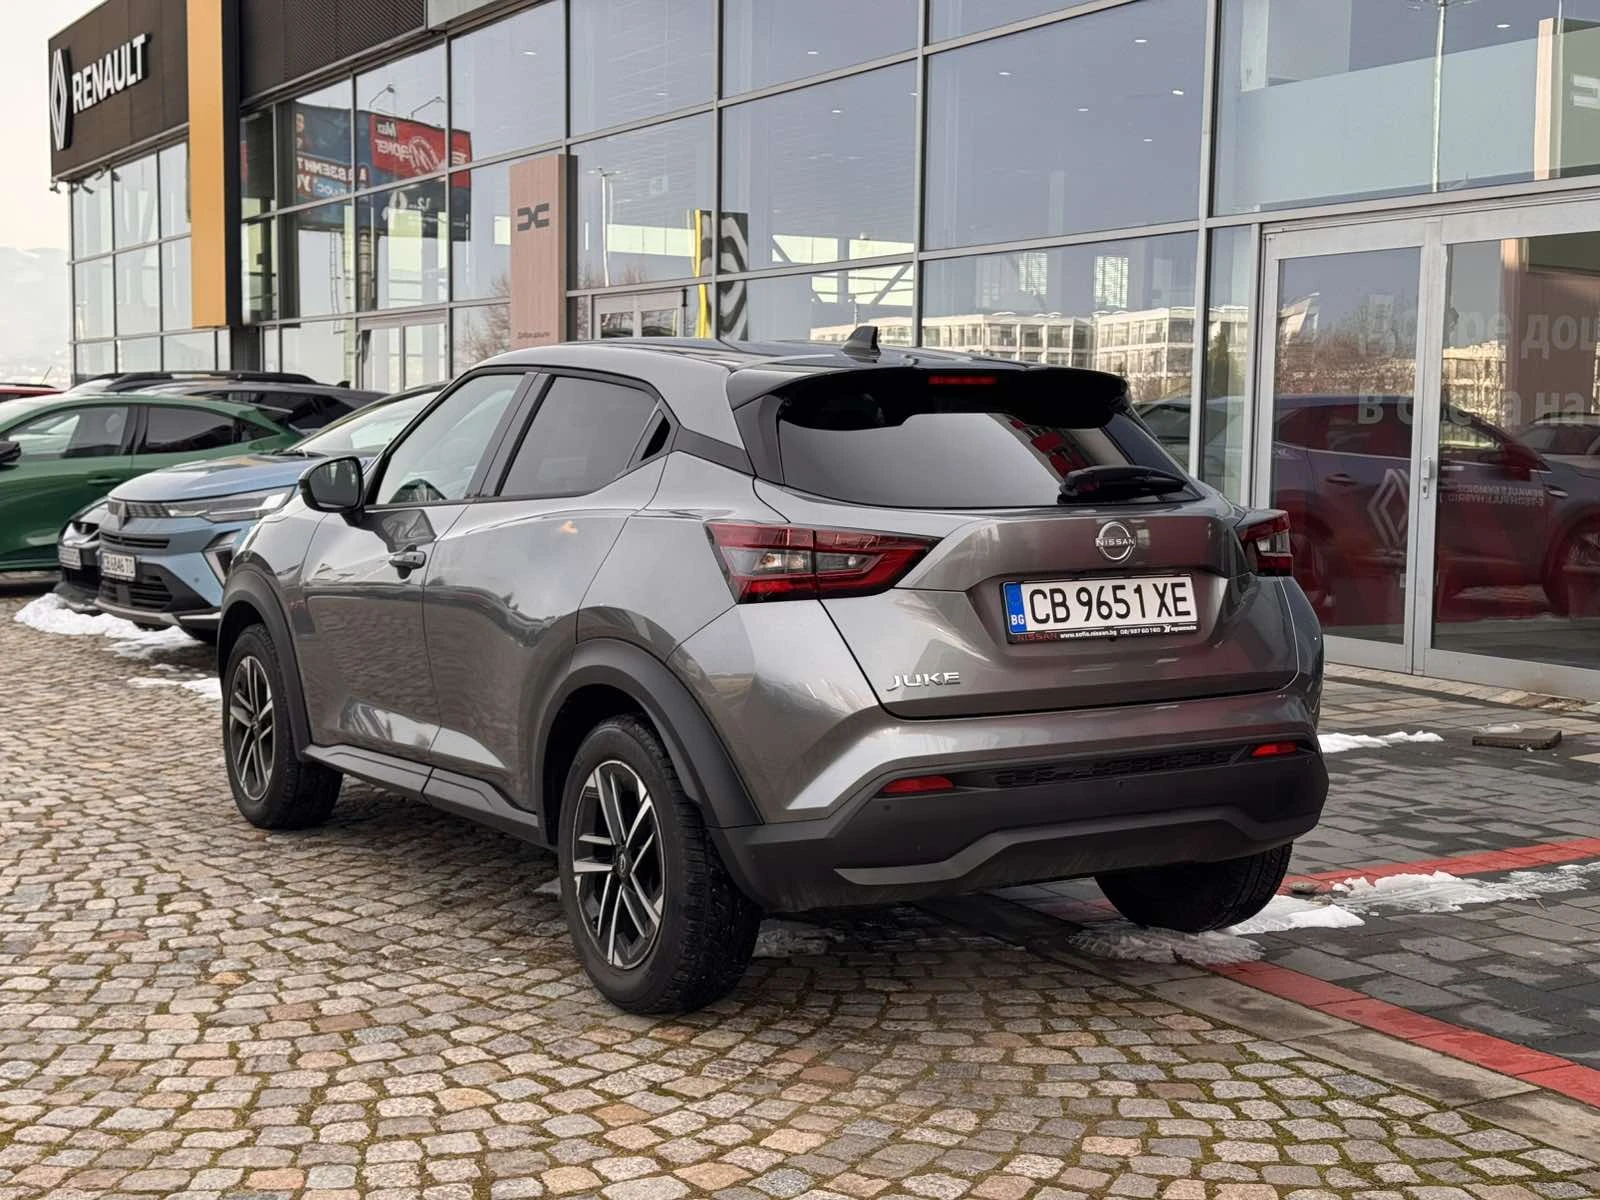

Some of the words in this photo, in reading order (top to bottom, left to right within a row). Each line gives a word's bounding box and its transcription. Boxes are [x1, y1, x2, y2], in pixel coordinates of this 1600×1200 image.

[72, 33, 146, 115] RENAULT
[1095, 537, 1136, 547] NISSAN
[1029, 587, 1070, 624] CB
[1075, 583, 1146, 622] 9651
[1152, 582, 1191, 618] XE
[1010, 614, 1025, 625] BG
[1017, 632, 1057, 641] NISSAN
[887, 672, 960, 692] JUKE
